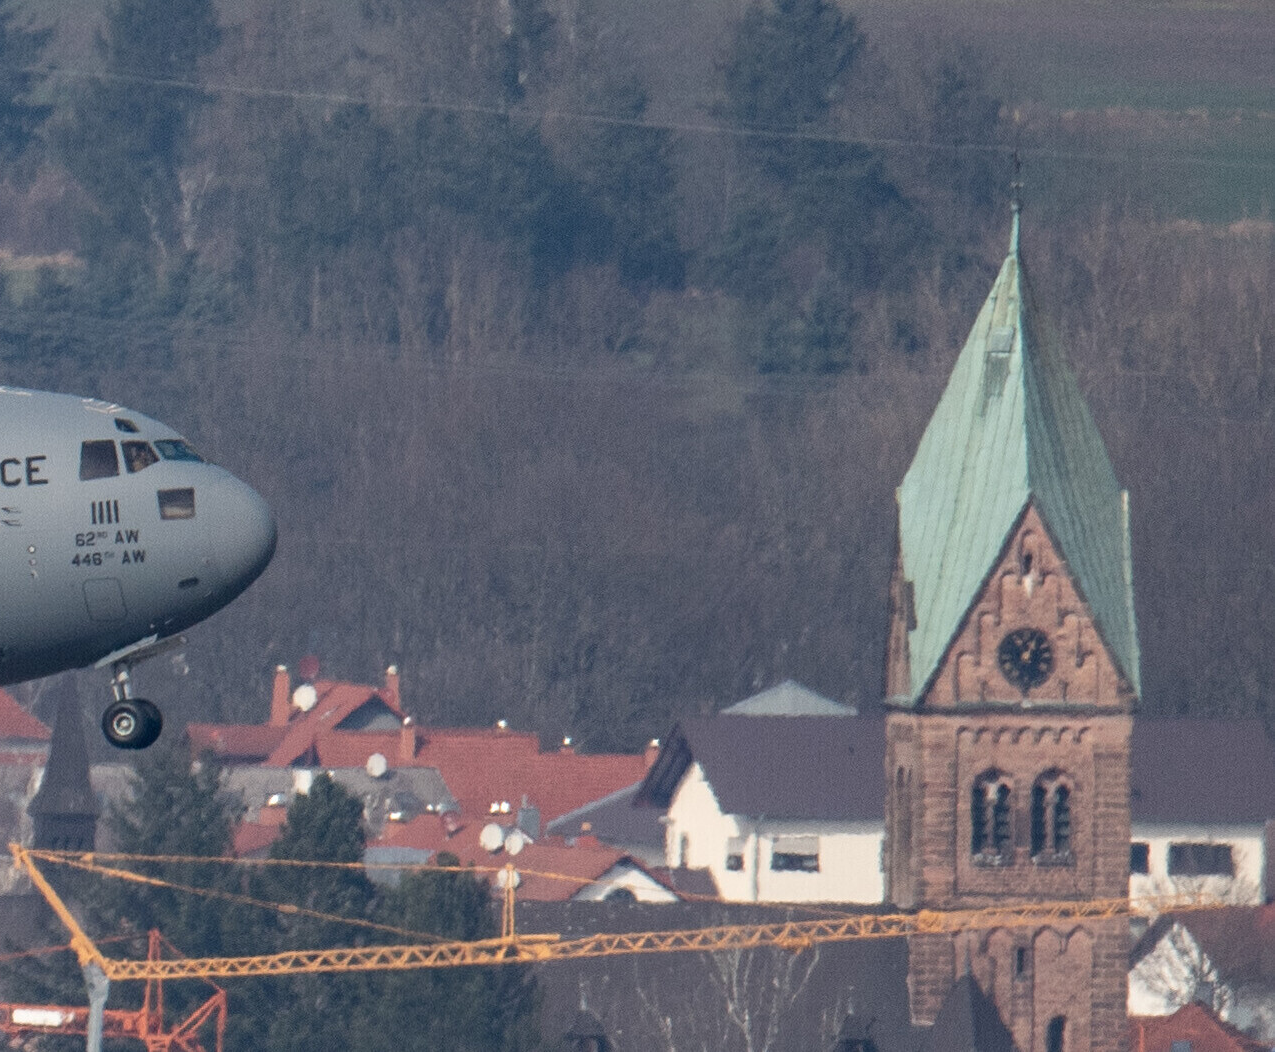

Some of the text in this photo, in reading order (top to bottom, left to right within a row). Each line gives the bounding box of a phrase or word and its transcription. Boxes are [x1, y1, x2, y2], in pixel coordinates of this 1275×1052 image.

[91, 499, 119, 525] 1111
[114, 530, 139, 544] AW
[121, 549, 146, 565] AW
